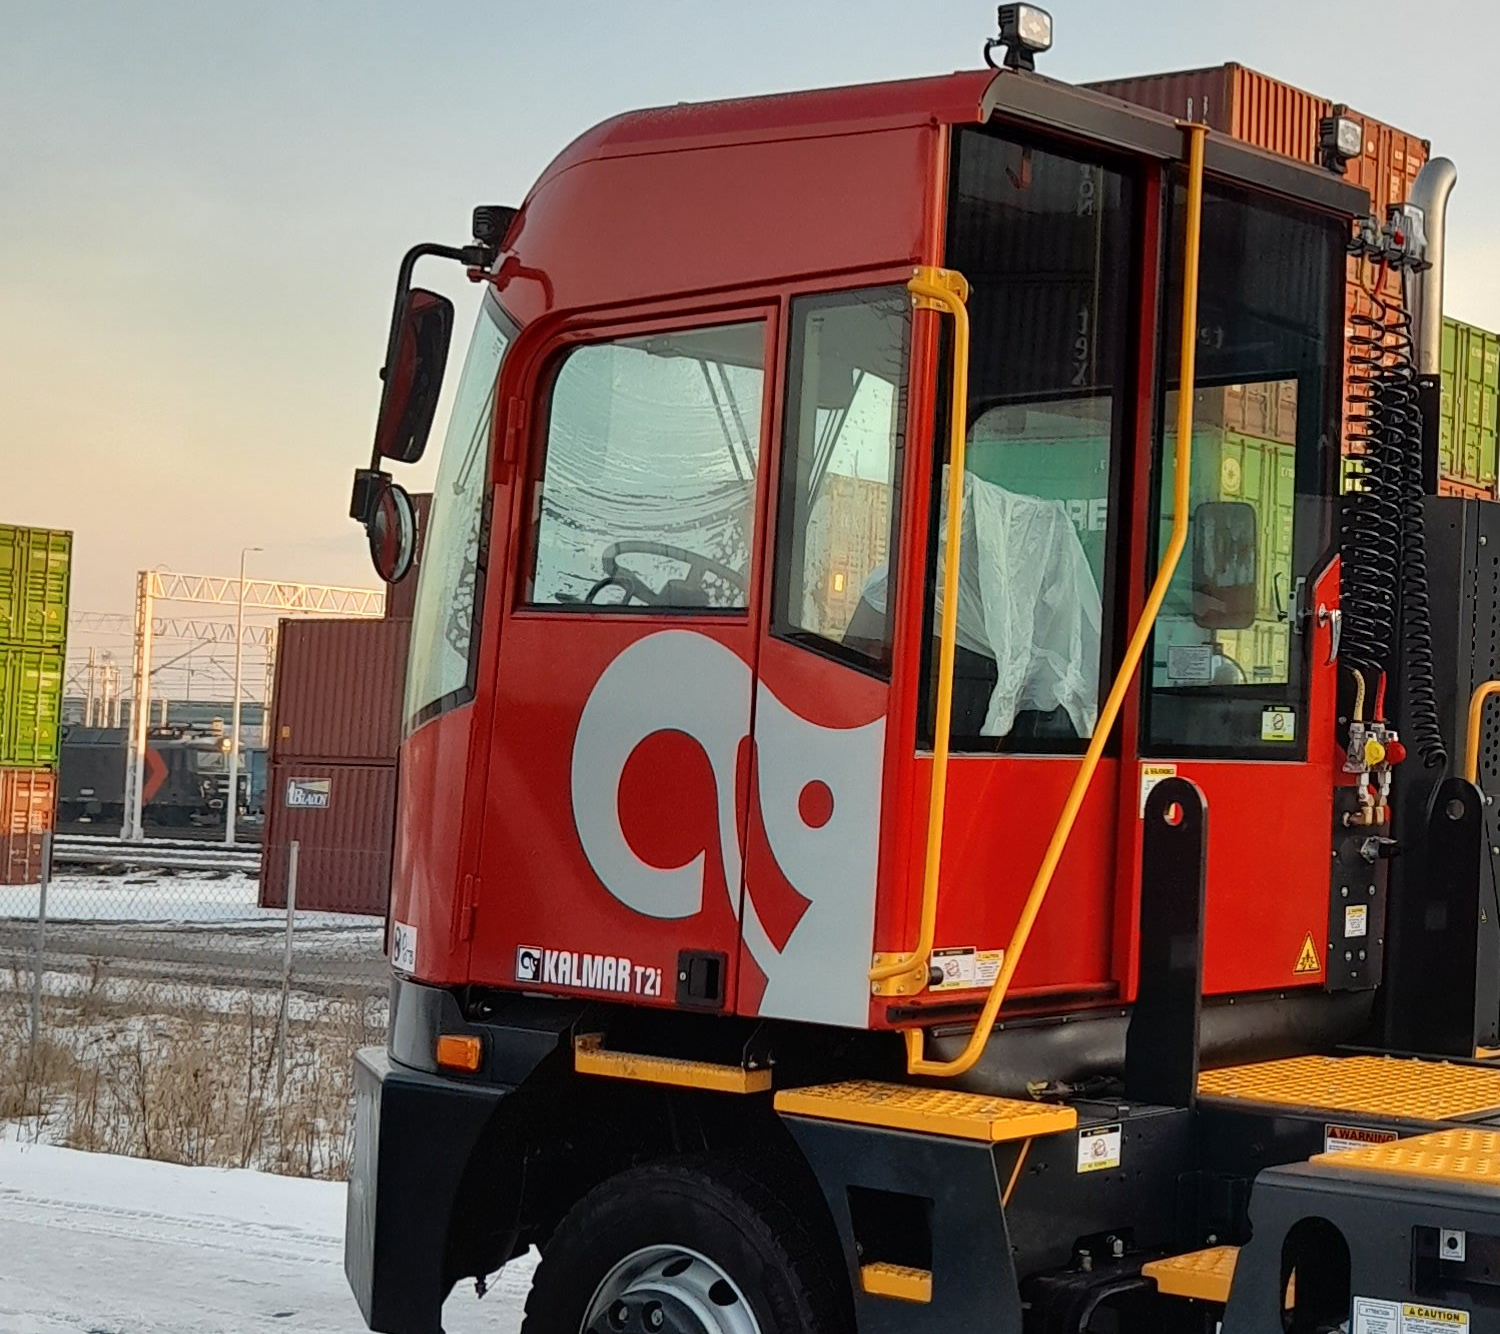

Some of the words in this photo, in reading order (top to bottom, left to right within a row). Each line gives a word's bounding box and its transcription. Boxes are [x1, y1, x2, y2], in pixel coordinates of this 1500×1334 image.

[543, 949, 631, 993] KALMAR
[634, 966, 663, 997] T2i
[1339, 1128, 1394, 1143] WARNING
[1418, 1307, 1460, 1321] CAUTION
